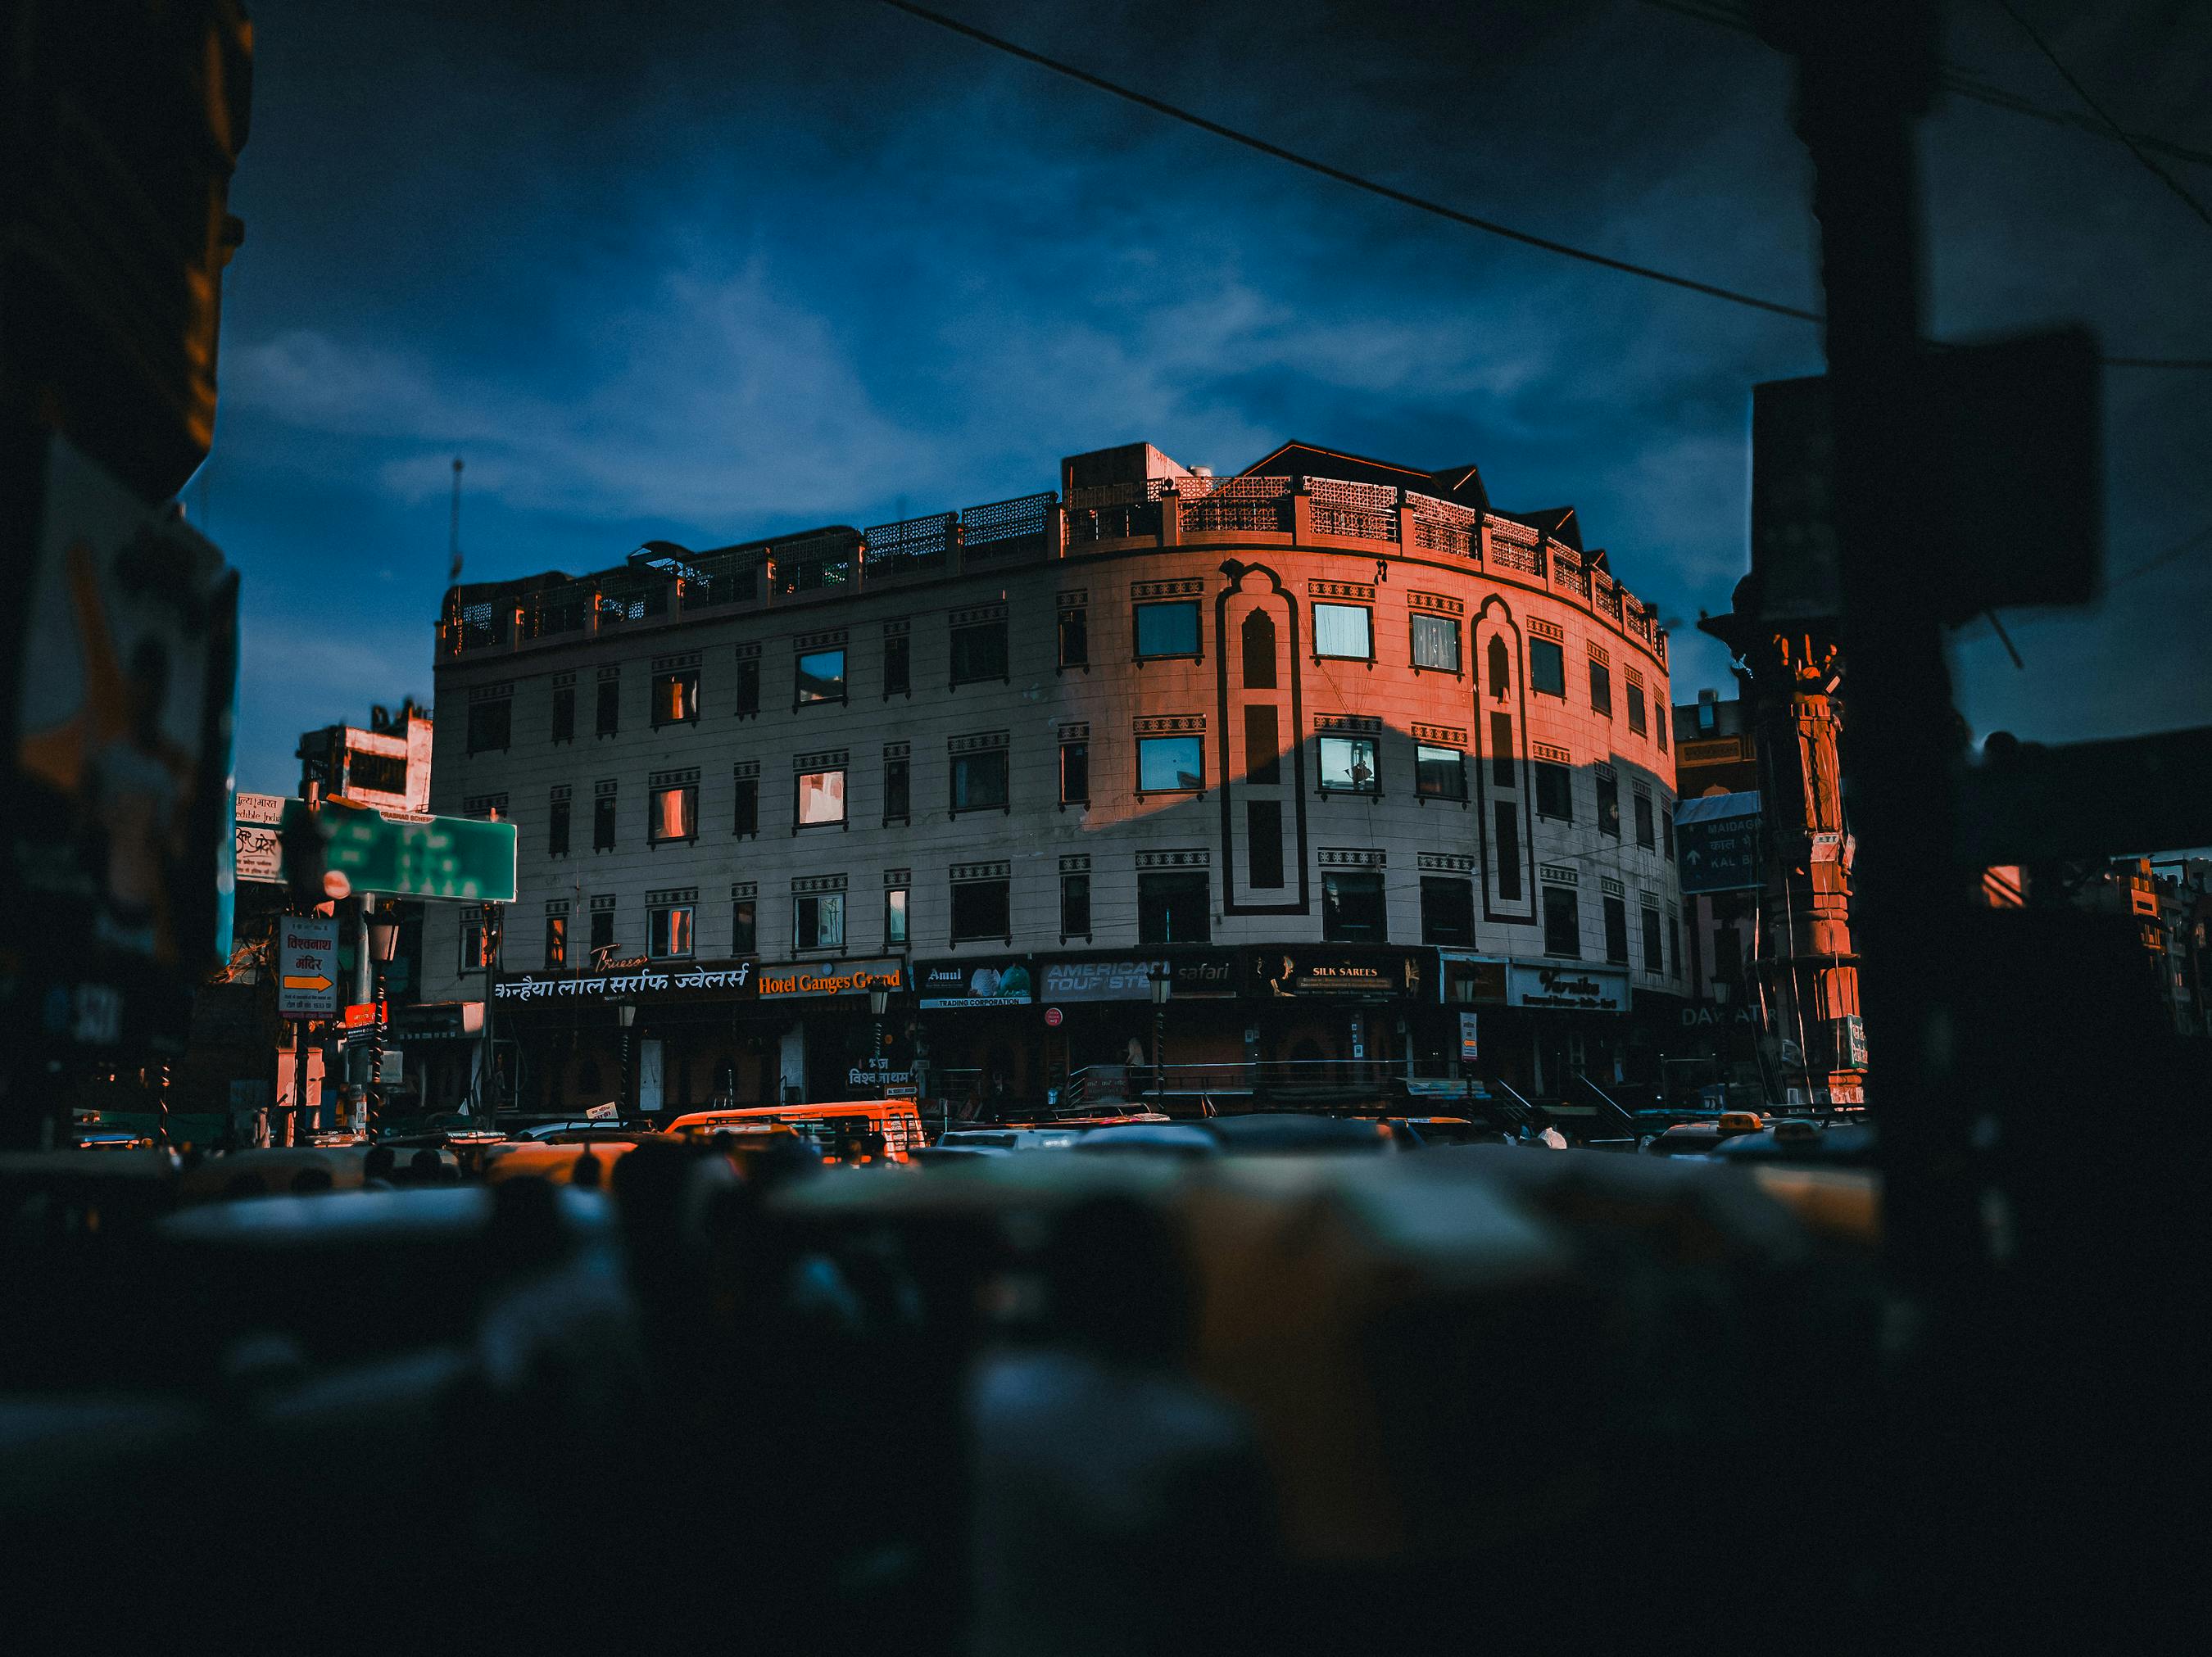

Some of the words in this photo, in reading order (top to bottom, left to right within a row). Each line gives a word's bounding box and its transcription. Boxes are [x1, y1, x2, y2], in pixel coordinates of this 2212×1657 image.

[236, 809, 261, 819] edible
[288, 934, 332, 951] विश्वनाथ
[295, 954, 323, 971] मंदिर
[1048, 962, 1171, 978] AMERICAN
[927, 968, 962, 981] Amul
[1178, 963, 1230, 980] safari
[1312, 967, 1336, 976] SILK
[1339, 968, 1378, 976] SAREES
[495, 976, 555, 1001] कन्हैया
[557, 978, 607, 996] लाल
[759, 976, 796, 994] Hotel
[799, 973, 851, 994] Ganges
[853, 970, 901, 989] Grnd
